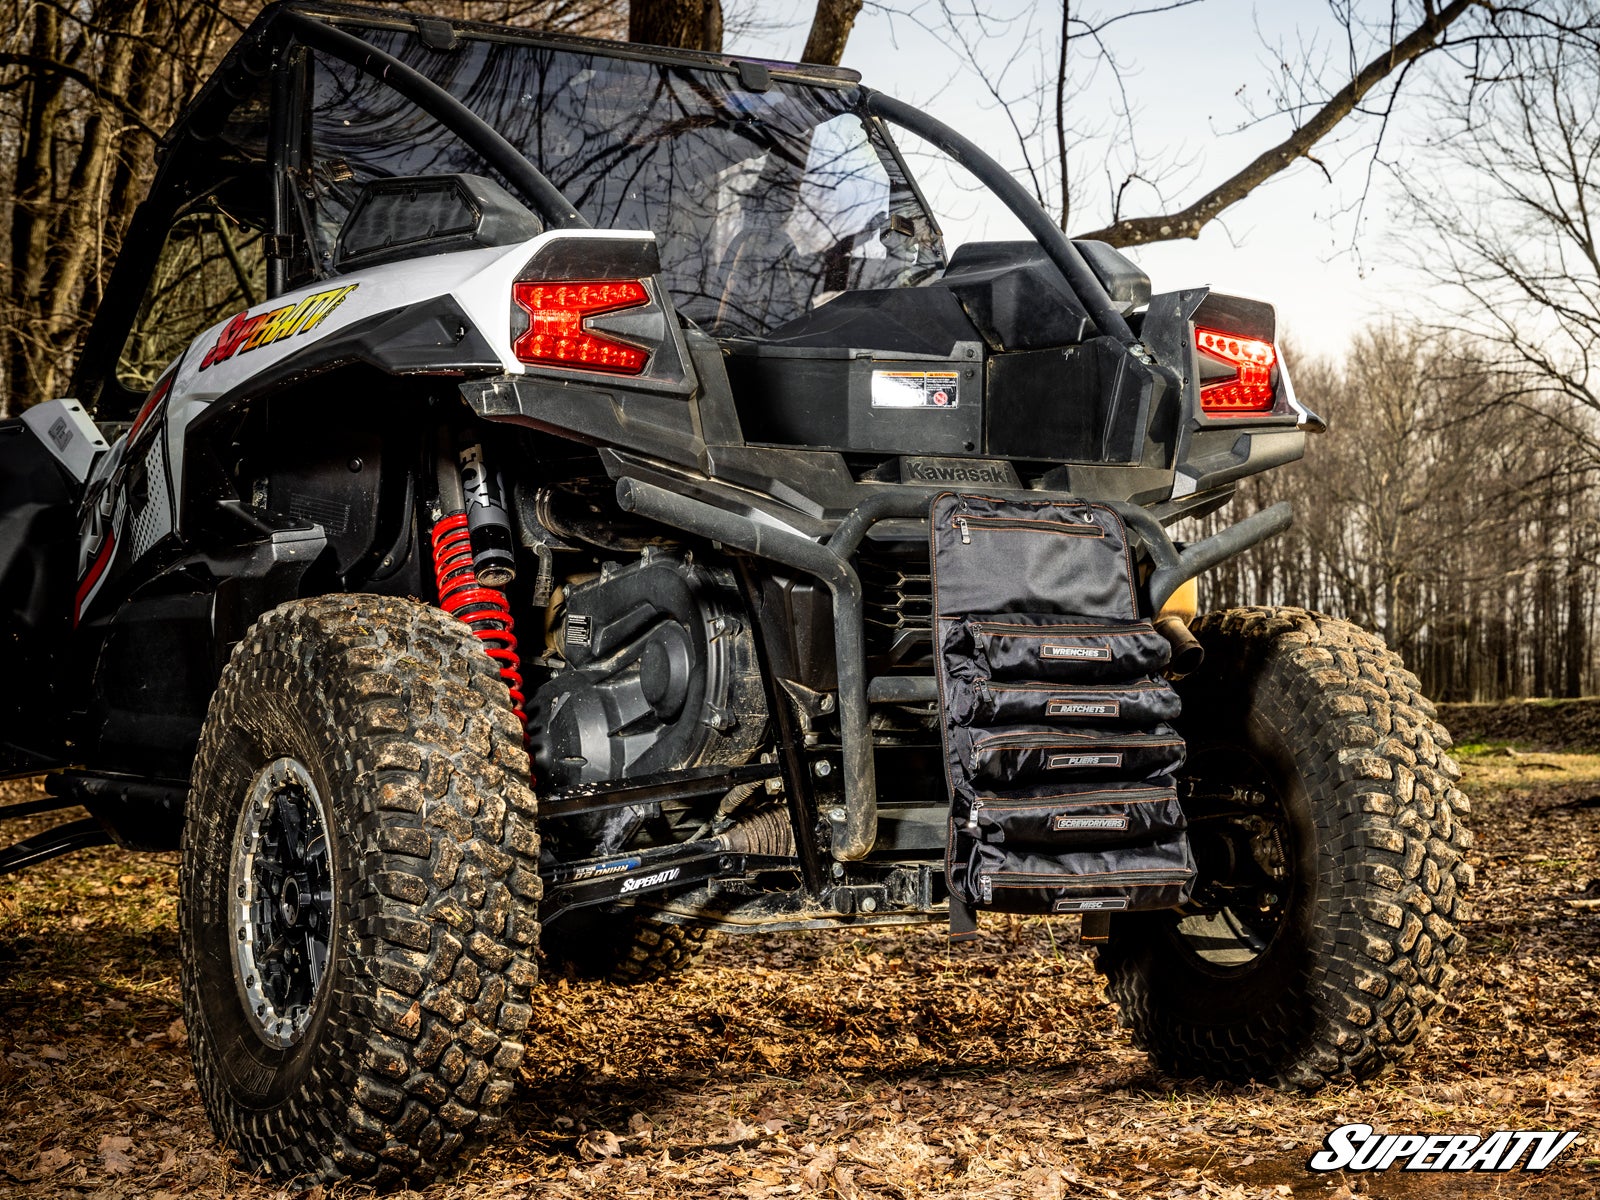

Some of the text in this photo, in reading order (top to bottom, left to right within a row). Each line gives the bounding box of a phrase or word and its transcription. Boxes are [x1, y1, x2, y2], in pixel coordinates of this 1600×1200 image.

[199, 282, 359, 372] SUPERATV
[906, 461, 1012, 483] Kawasaki
[459, 443, 490, 516] FOX
[1052, 647, 1099, 657] WRENCHES
[1060, 705, 1105, 713] RATCHETS
[1068, 757, 1099, 765] PLIERS
[1060, 819, 1123, 828] SCREWDRIVERS
[593, 864, 629, 877] RHINO
[620, 867, 680, 893] SUPERATV
[1079, 901, 1103, 909] MISC
